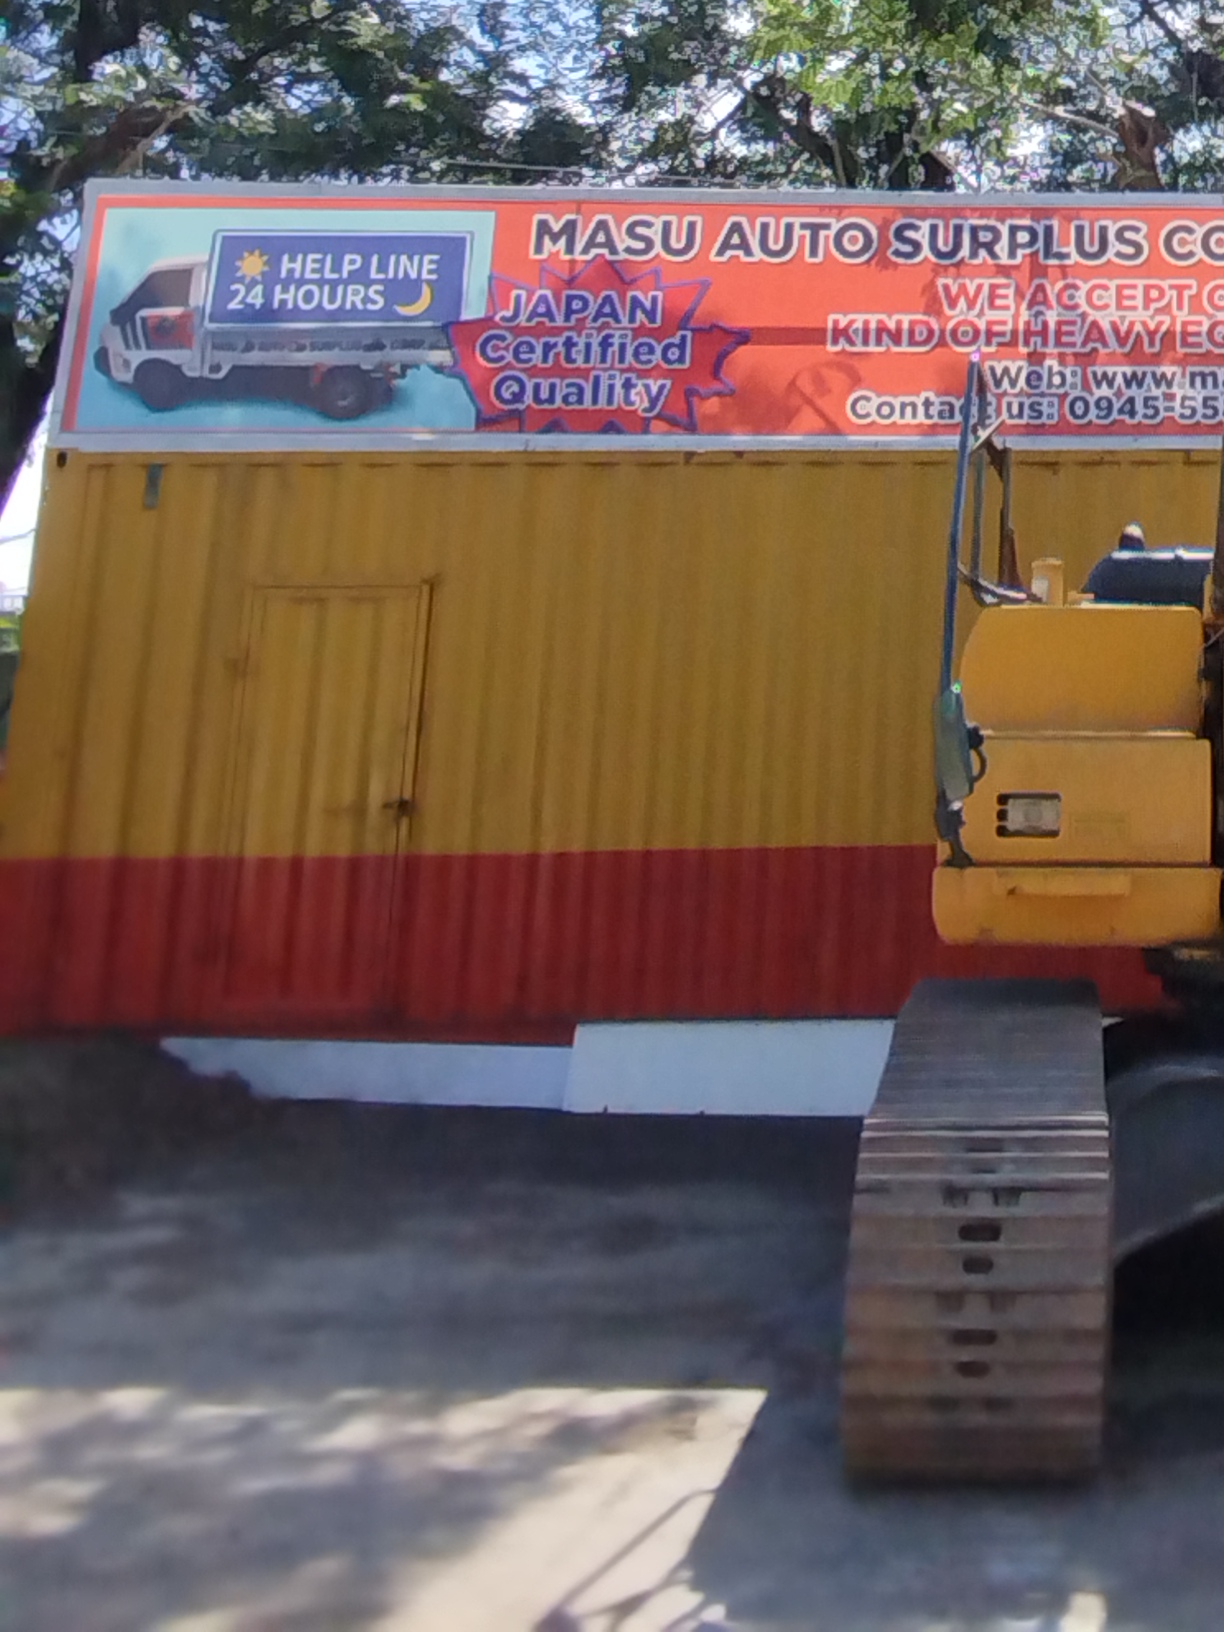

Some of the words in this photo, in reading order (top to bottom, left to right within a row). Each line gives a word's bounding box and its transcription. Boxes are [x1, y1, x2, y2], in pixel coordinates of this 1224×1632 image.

[531, 216, 700, 259] MASU
[711, 218, 876, 261] AUTO
[891, 219, 1147, 264] SURPLUS
[279, 253, 363, 279] HELP
[369, 254, 440, 280] LINE
[227, 283, 265, 310] 24
[272, 284, 385, 310] HOURS
[497, 291, 661, 325] JAPAN
[940, 280, 1015, 311] WE
[1026, 281, 1195, 313] ACCEPT
[477, 331, 690, 366] Certified
[829, 316, 937, 349] KIND
[948, 318, 1011, 349] OF
[1022, 319, 1169, 351] HEAVY
[492, 372, 669, 414] Quality
[988, 364, 1078, 390] Web:
[849, 392, 996, 422] Conta
[1004, 399, 1056, 421] us:
